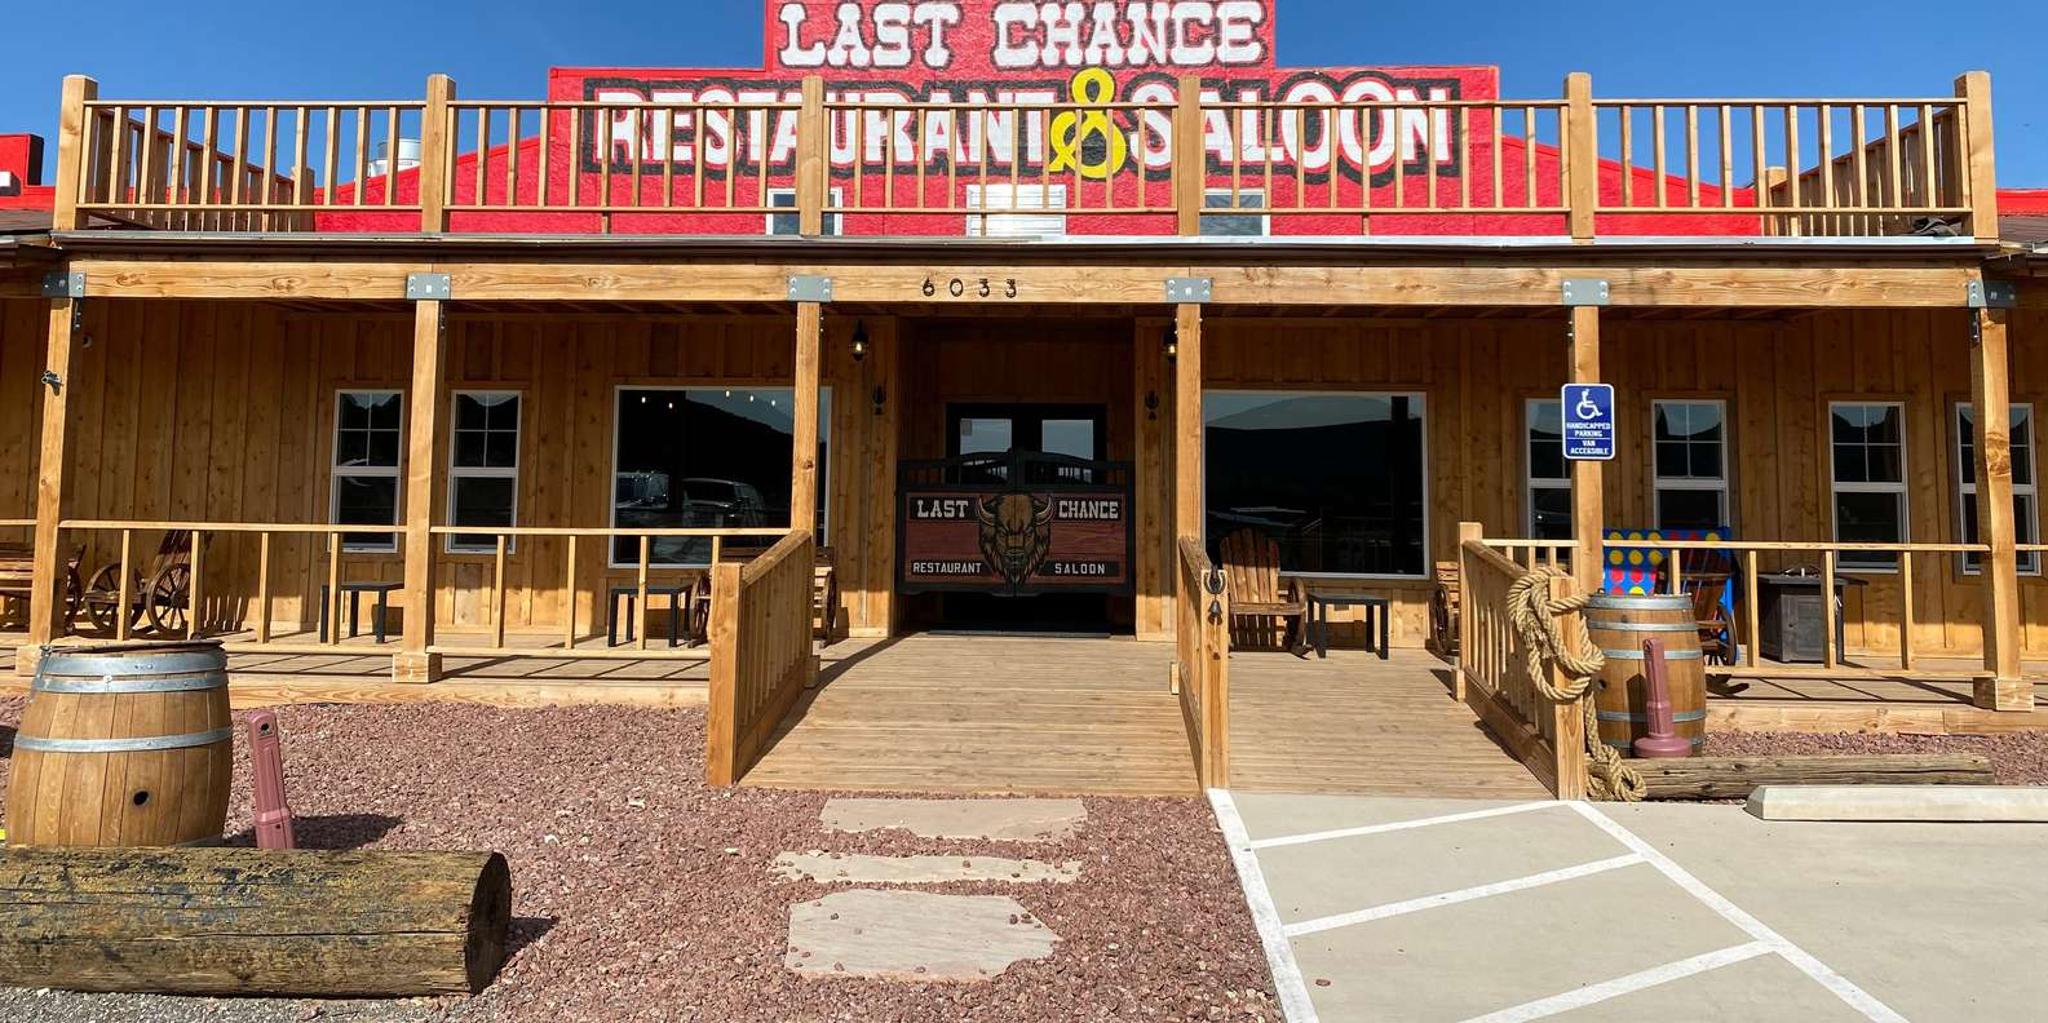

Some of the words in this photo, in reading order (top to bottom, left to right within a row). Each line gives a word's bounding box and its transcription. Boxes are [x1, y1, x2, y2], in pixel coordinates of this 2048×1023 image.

[779, 1, 962, 68] LAST
[993, 0, 1263, 67] CHANCE
[596, 89, 1055, 164] RESTAURANT
[1049, 67, 1126, 178] &
[1130, 81, 1449, 168] SALOON
[922, 277, 1017, 298] 6033
[917, 500, 968, 518] LAST
[1058, 501, 1119, 519] CHANCE
[913, 563, 982, 573] RESTAURANT
[1055, 563, 1105, 574] SALOON
